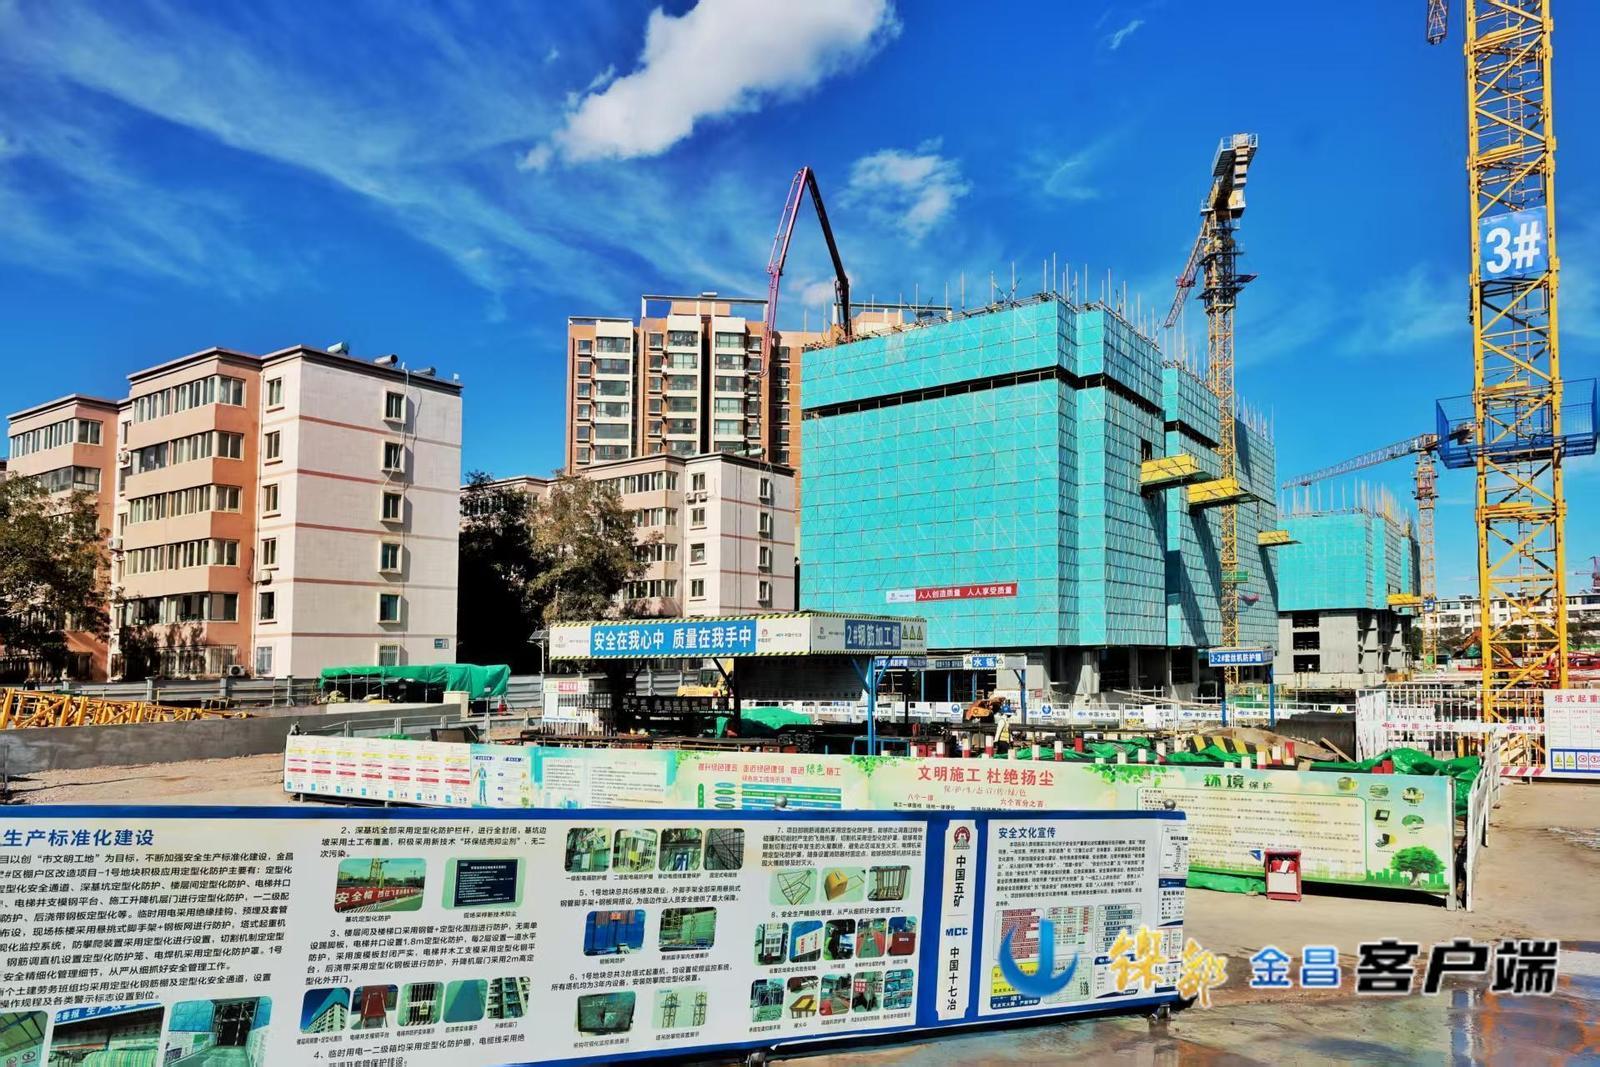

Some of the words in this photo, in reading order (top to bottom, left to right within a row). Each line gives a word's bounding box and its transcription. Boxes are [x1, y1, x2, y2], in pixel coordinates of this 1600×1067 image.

[1486, 221, 1541, 273] 3#
[593, 628, 665, 652] 安全在我心中
[672, 624, 752, 649] 质量在我手中
[1555, 694, 1600, 704] 塔式起重
[917, 765, 982, 783] 文明施工
[986, 768, 1055, 787] 杜绝扬尘
[0, 829, 155, 847] 生产标准化建设
[998, 827, 1057, 840] 安全文化宣传
[953, 855, 966, 907] 中国五矿
[945, 928, 968, 937] MCC
[946, 946, 960, 1011] 中国十七冶
